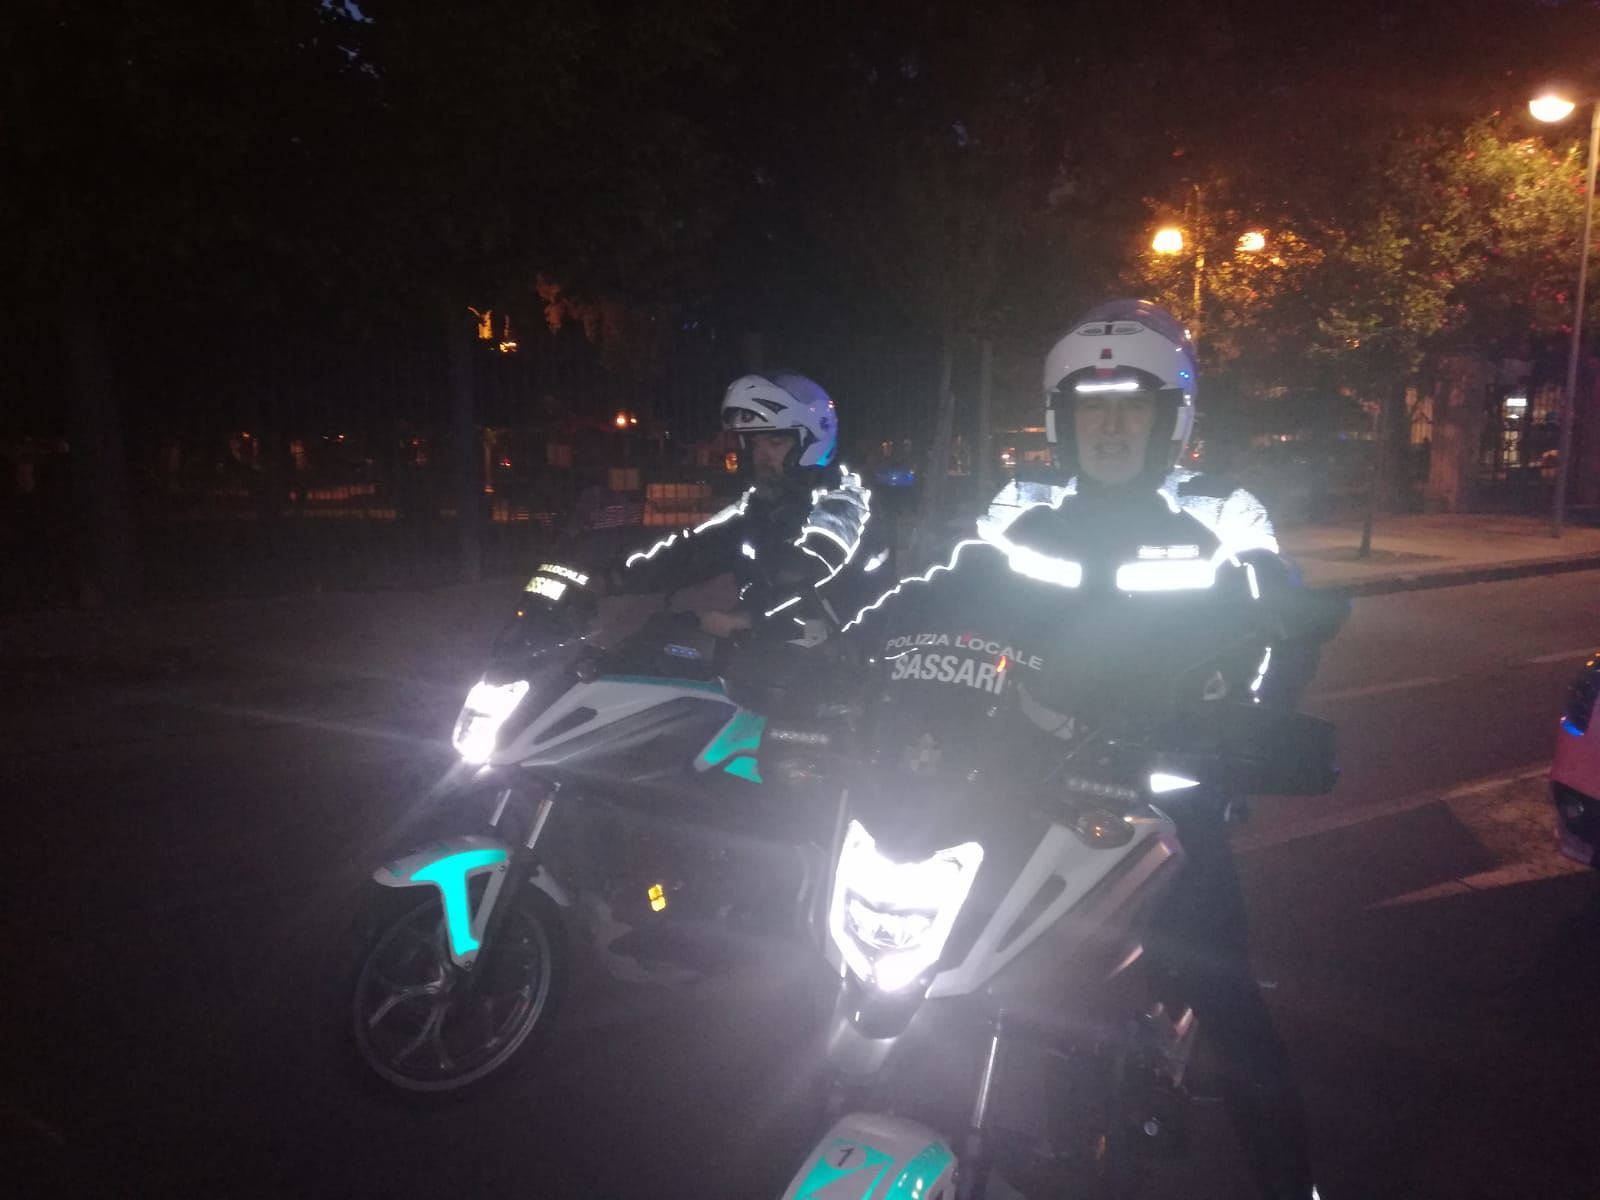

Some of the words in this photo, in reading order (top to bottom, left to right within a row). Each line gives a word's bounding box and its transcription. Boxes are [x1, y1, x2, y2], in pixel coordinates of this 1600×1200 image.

[886, 633, 949, 650] POLIZIA
[955, 635, 1044, 671] LOCALE
[891, 654, 1006, 694] SASSARI
[837, 1147, 854, 1167] 1
